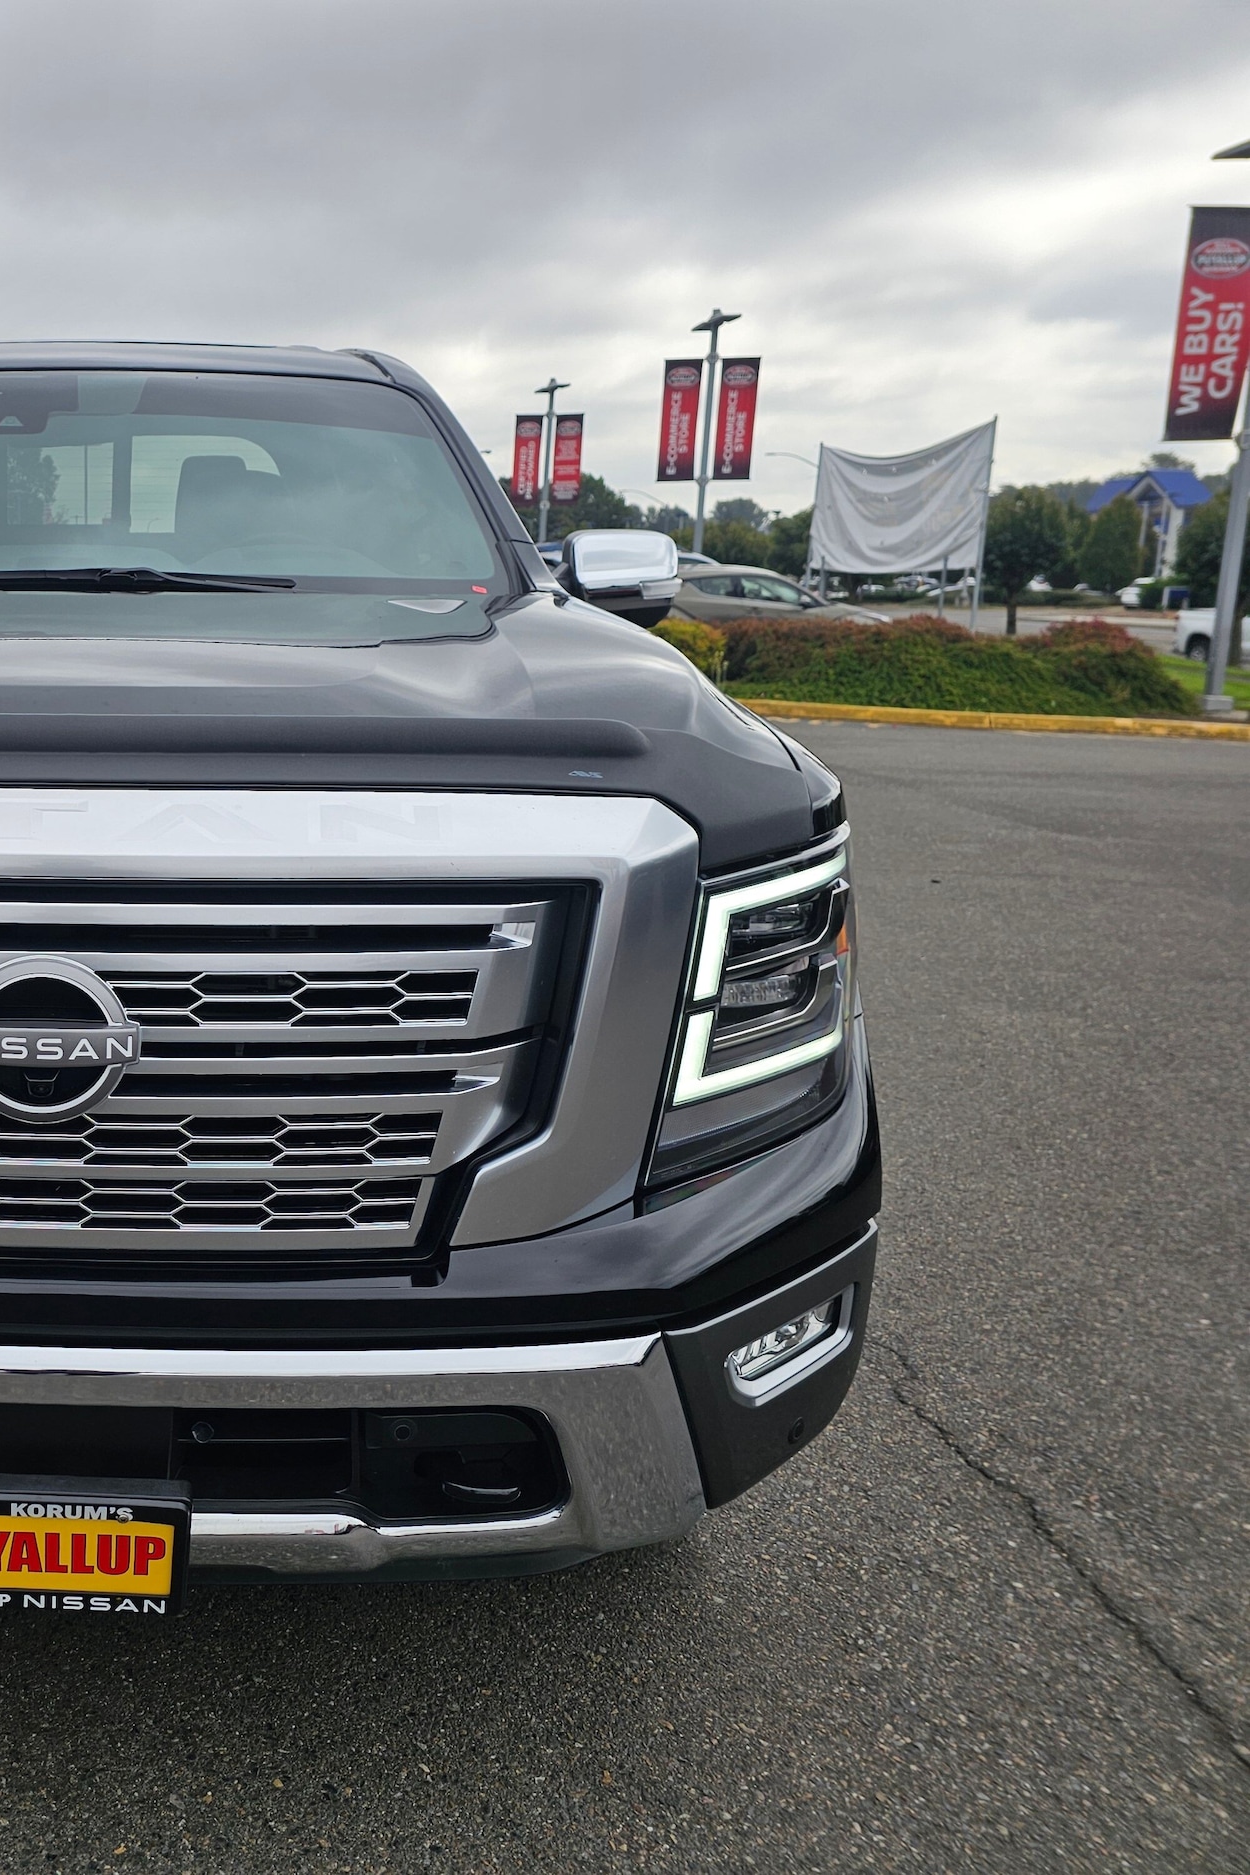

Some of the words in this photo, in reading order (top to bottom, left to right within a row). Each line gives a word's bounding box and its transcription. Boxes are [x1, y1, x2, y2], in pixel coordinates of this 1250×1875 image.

[1183, 286, 1215, 355] BUY
[1207, 302, 1245, 400] CARS!
[1174, 363, 1206, 416] WE
[665, 391, 683, 475] E-COMMERCE
[677, 412, 691, 454] STORE
[721, 389, 739, 474] E-COMMERCE
[734, 411, 748, 453] STORE
[10, 1503, 134, 1523] KORUM'S
[23, 1594, 167, 1614] NISSAN
